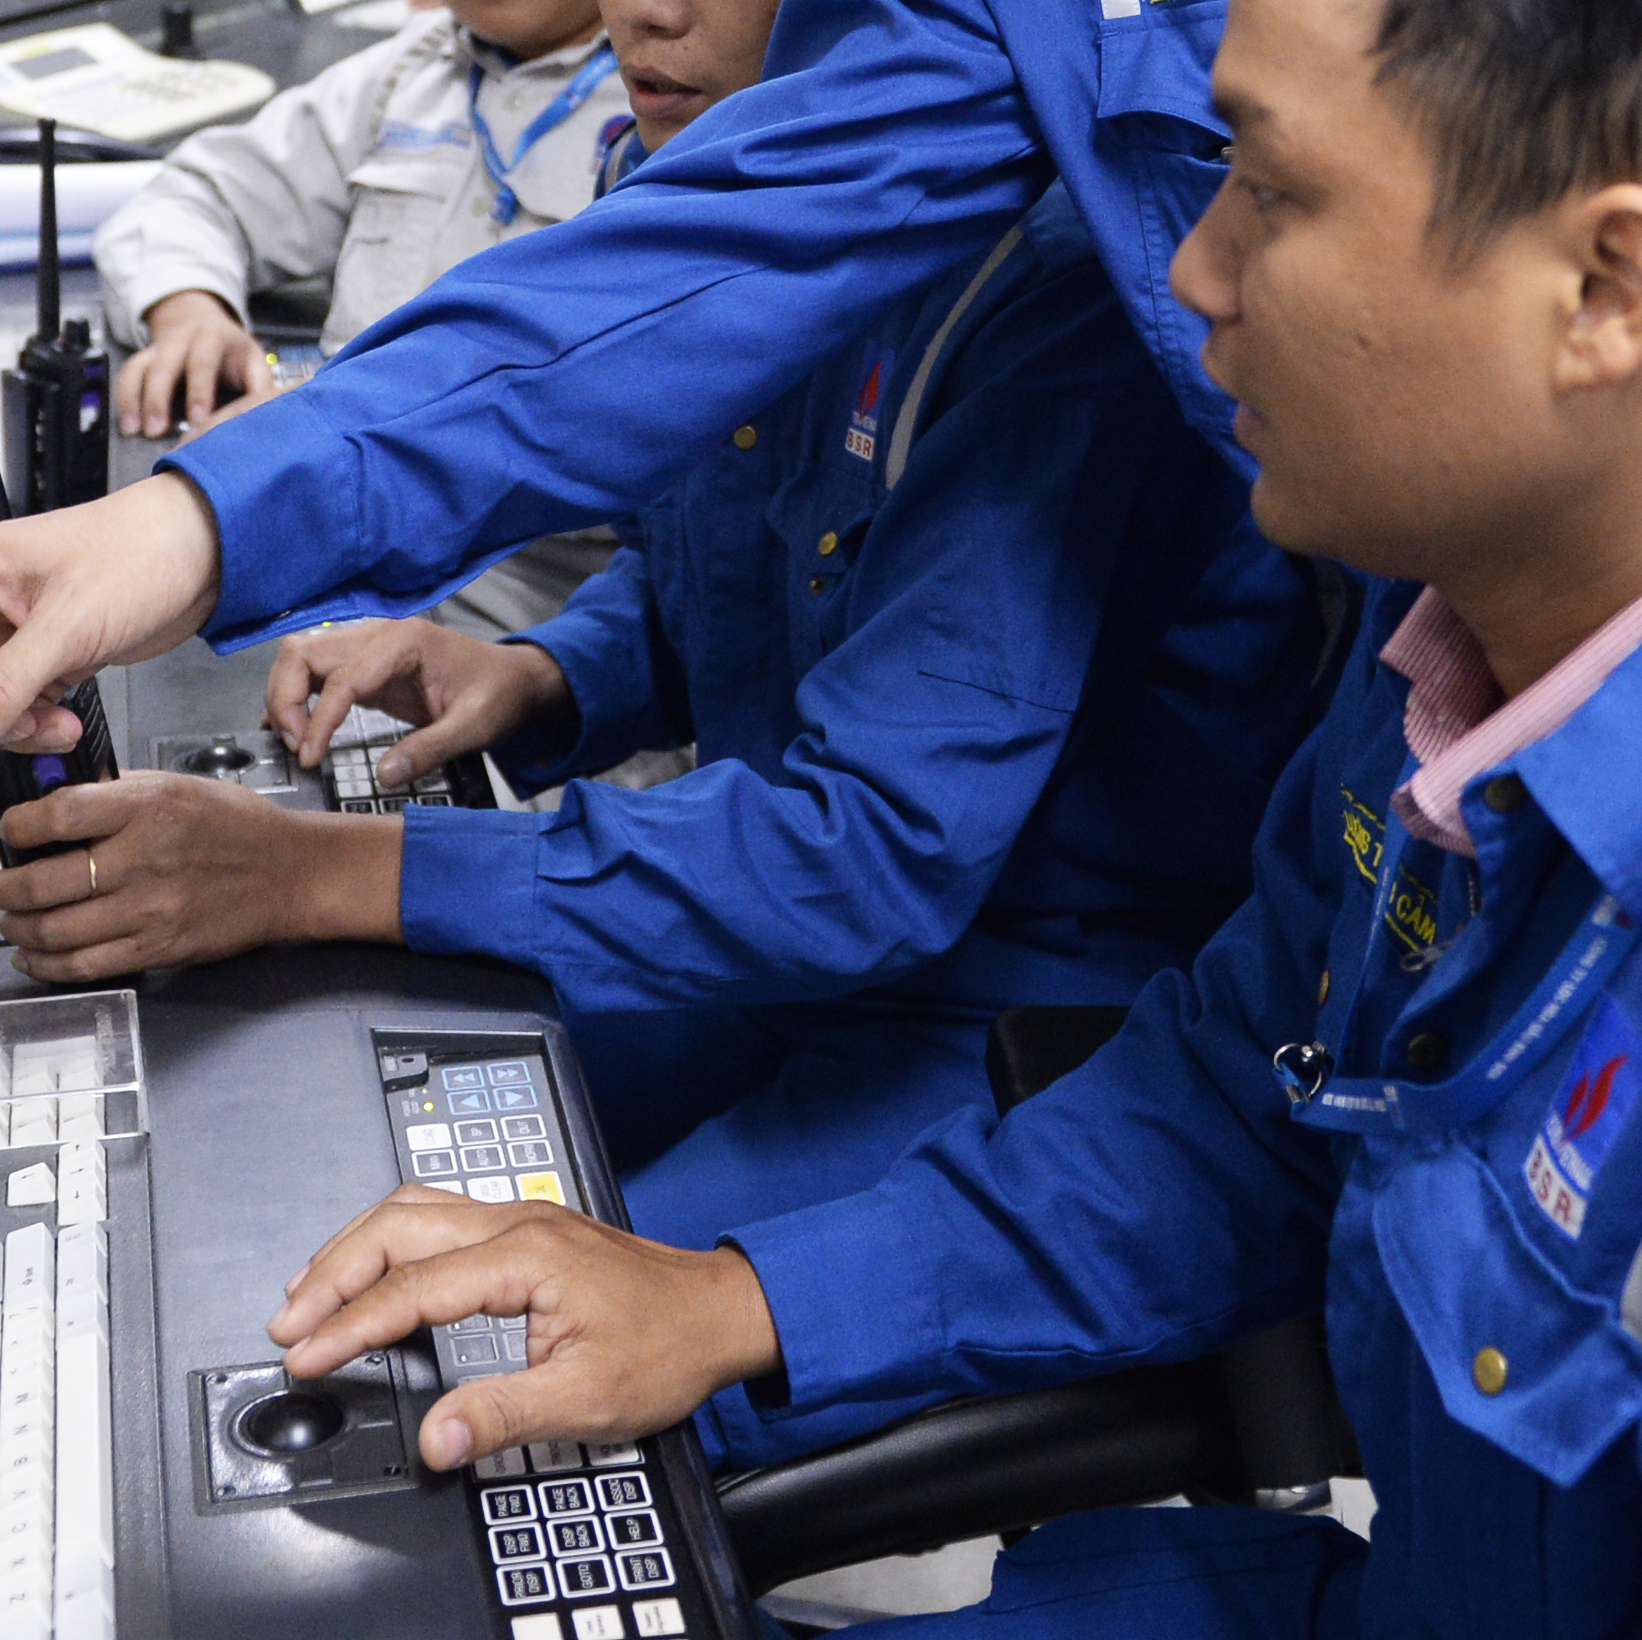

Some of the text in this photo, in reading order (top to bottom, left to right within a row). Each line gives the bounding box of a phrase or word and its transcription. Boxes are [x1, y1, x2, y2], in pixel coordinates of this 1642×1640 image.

[847, 431, 873, 457] BSR
[15, 1392, 29, 1404] M
[14, 1423, 28, 1435] N
[13, 1455, 28, 1468] B
[12, 1489, 27, 1501] V
[495, 1494, 508, 1517] PAGE
[509, 1494, 522, 1514] FWD
[552, 1487, 566, 1510] PAGE
[566, 1485, 581, 1508] BACK
[11, 1522, 27, 1534] C
[562, 1526, 576, 1548] DISP
[576, 1524, 590, 1547] BACK
[626, 1517, 641, 1540] HELP
[503, 1534, 517, 1554] DISP
[517, 1531, 530, 1552] FWD
[10, 1556, 26, 1569] X
[645, 1557, 660, 1578] DISP
[526, 1571, 540, 1594] DISP
[578, 1563, 593, 1589] GOTO
[9, 1592, 25, 1604] Z
